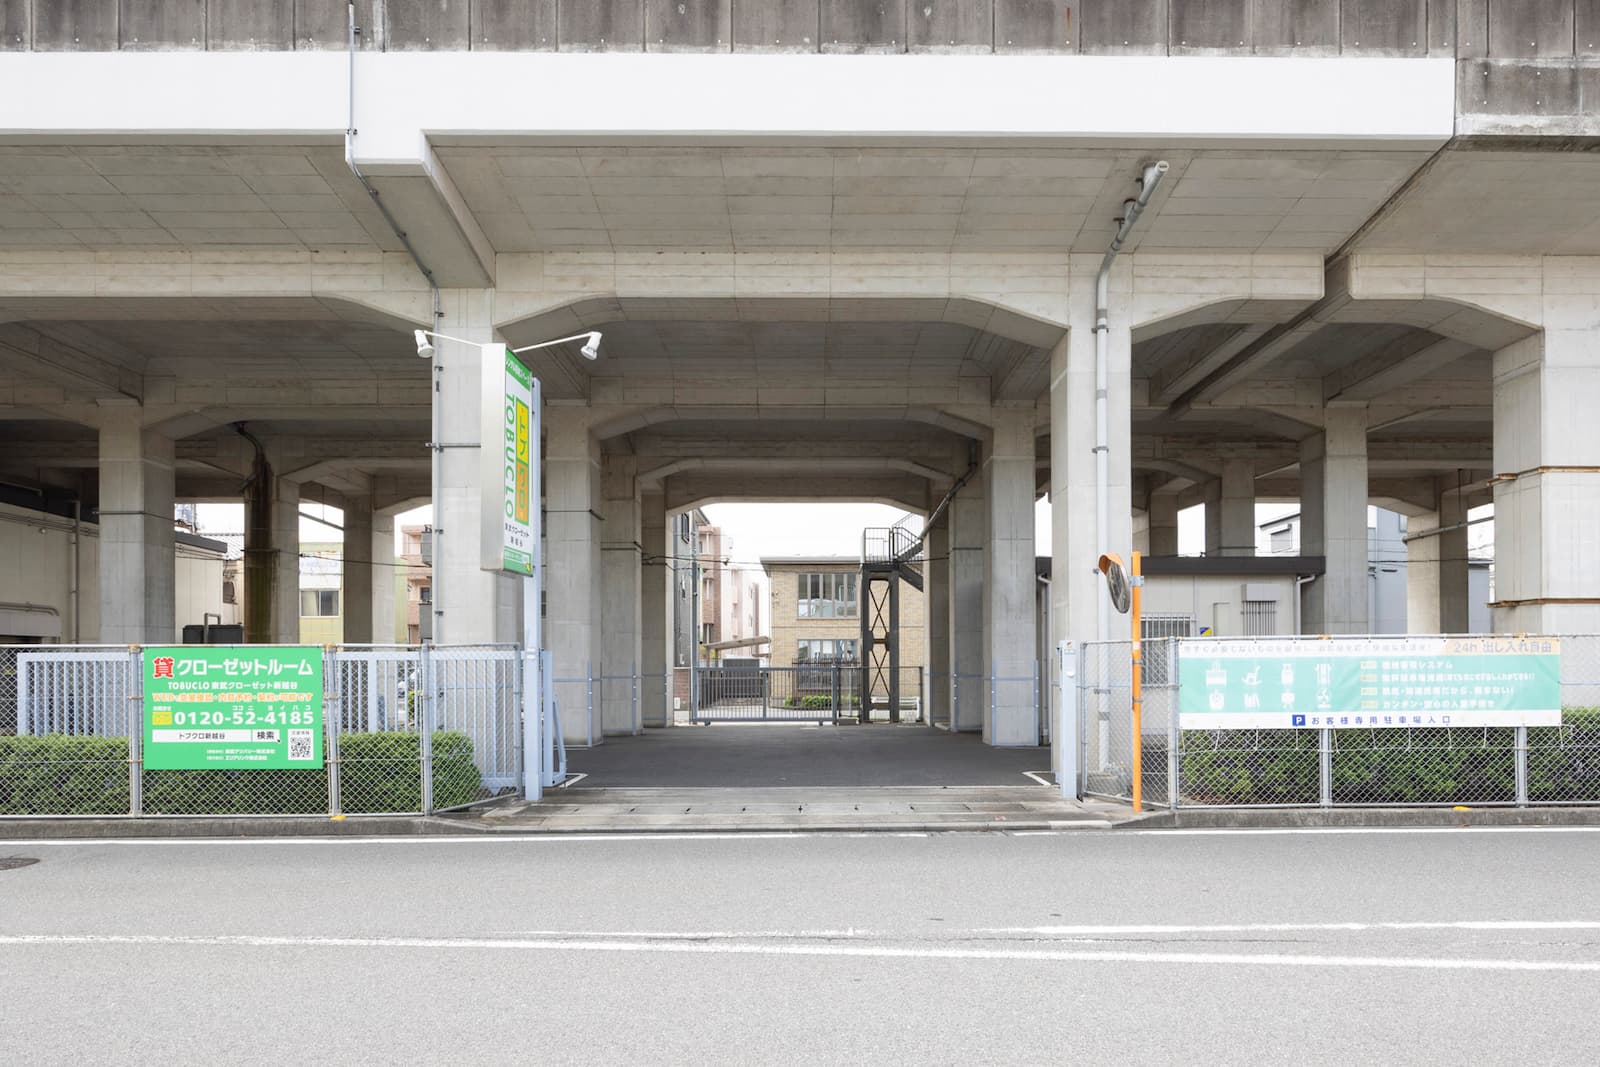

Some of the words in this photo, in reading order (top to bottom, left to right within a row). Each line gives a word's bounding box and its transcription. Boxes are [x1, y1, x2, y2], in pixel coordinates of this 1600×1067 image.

[505, 394, 515, 519] TOBUCLO
[1454, 641, 1478, 653] 24h
[1482, 641, 1552, 653] 出し入れ自由
[152, 656, 175, 678] 貸
[177, 658, 313, 676] クローゼットルーム
[168, 682, 210, 690] TOBUCLO
[211, 681, 298, 690] 東武クローゼット新越谷
[174, 711, 314, 725] 0120-52-4185
[1311, 715, 1451, 726] お客様専用駐車場入口
[257, 731, 275, 740] 検索
